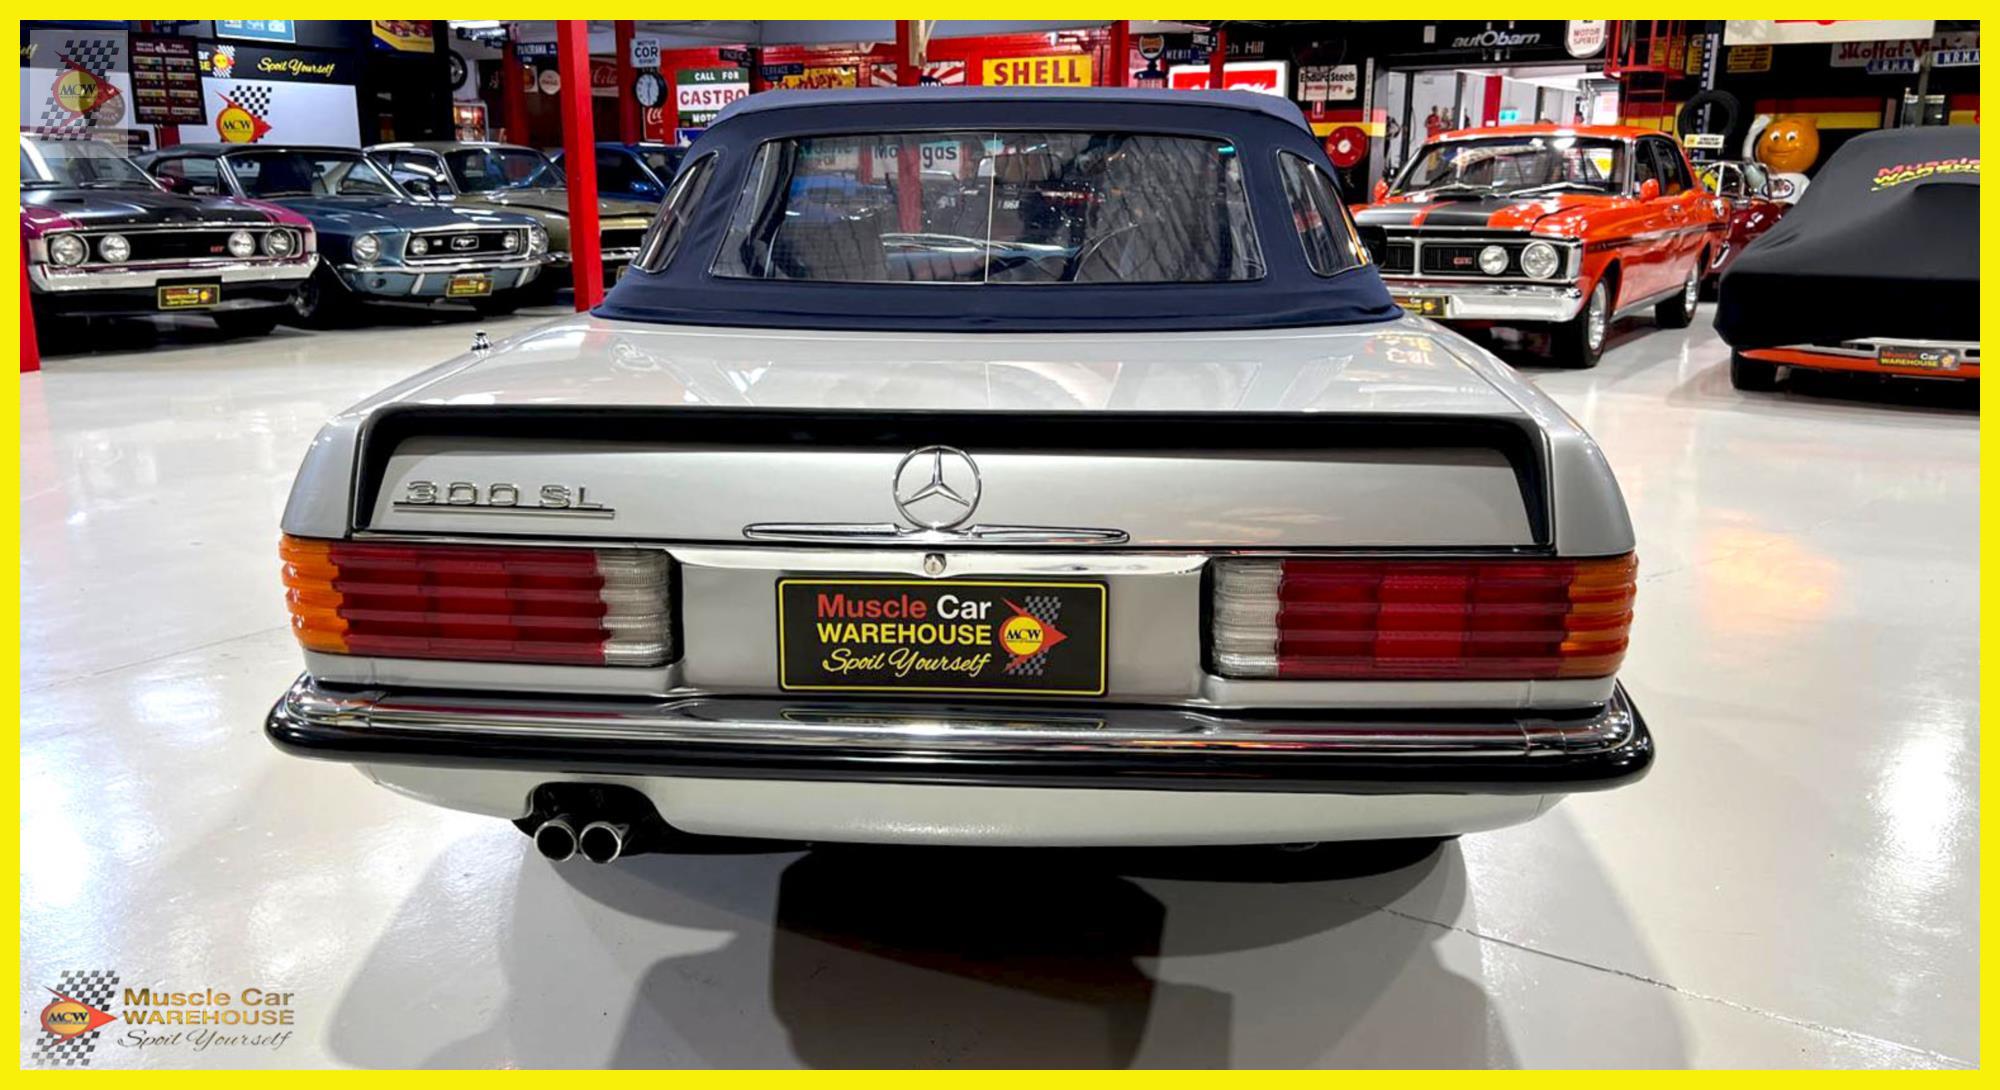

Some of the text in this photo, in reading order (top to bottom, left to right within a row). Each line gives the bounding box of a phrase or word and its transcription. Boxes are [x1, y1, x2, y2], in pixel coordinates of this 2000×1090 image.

[1574, 28, 1600, 37] MOTOR
[634, 46, 658, 58] COR
[1944, 52, 1980, 64] NRMA
[257, 56, 336, 78] Spoil Yourself
[994, 60, 1081, 85] SHELL
[694, 70, 739, 81] CALL FOR
[1880, 357, 1939, 367] WAREHOUSE
[1919, 352, 1939, 360] Car
[407, 481, 603, 510] 300 SL
[817, 594, 992, 620] Muscle Car
[817, 622, 992, 646] WAREHOUSE
[1006, 628, 1041, 640] MCW
[822, 648, 991, 677] Spoil Yourself
